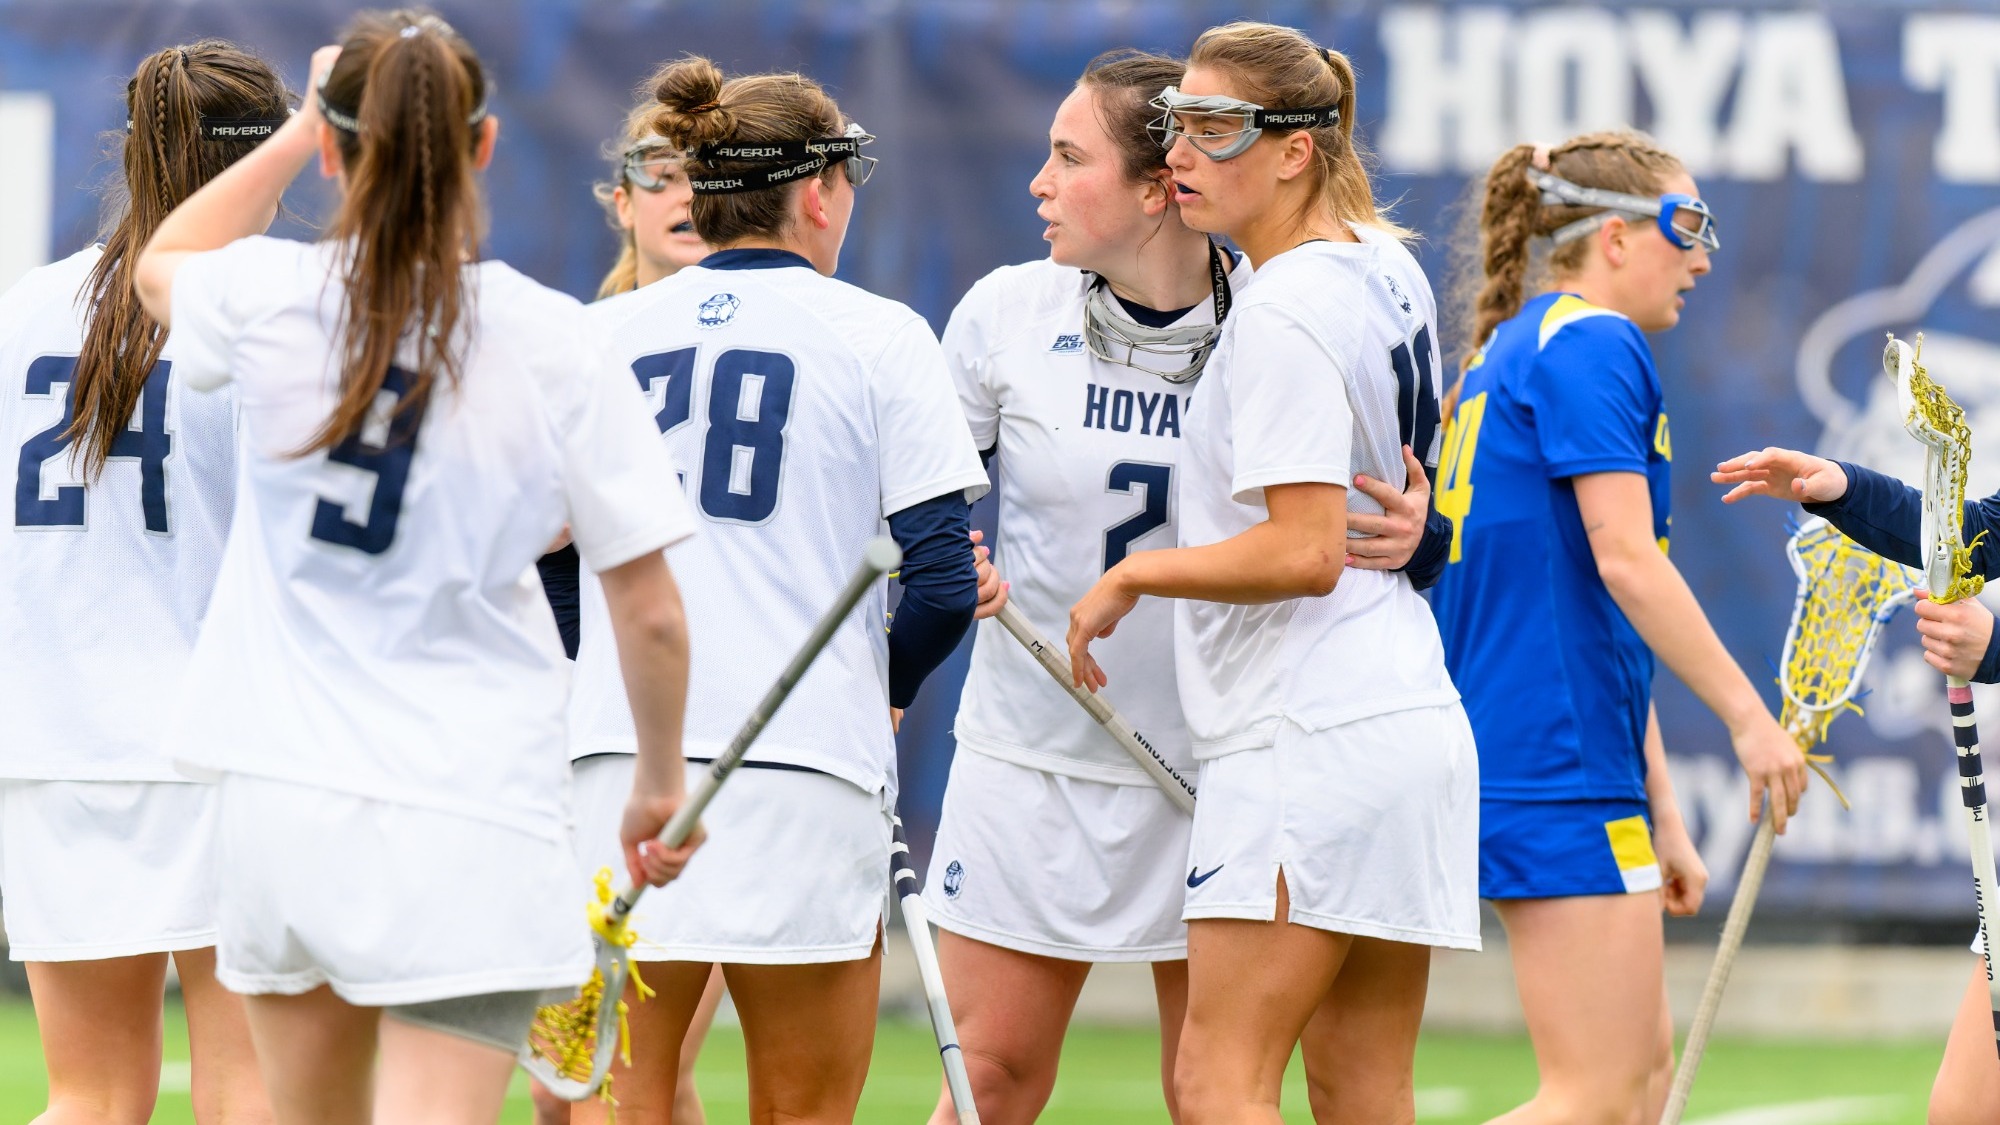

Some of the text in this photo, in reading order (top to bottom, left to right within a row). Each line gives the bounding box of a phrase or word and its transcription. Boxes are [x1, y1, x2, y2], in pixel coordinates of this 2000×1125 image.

[1380, 8, 1863, 183] HOYA
[1264, 113, 1316, 124] MAVERIK
[212, 126, 272, 136] MAVERIK
[716, 142, 854, 158] AVERIK MAVERI
[1052, 341, 1085, 349] EAST
[1056, 334, 1081, 342] BIG
[1083, 383, 1192, 438] HOYA
[14, 353, 174, 535] 24
[309, 365, 433, 555] 9
